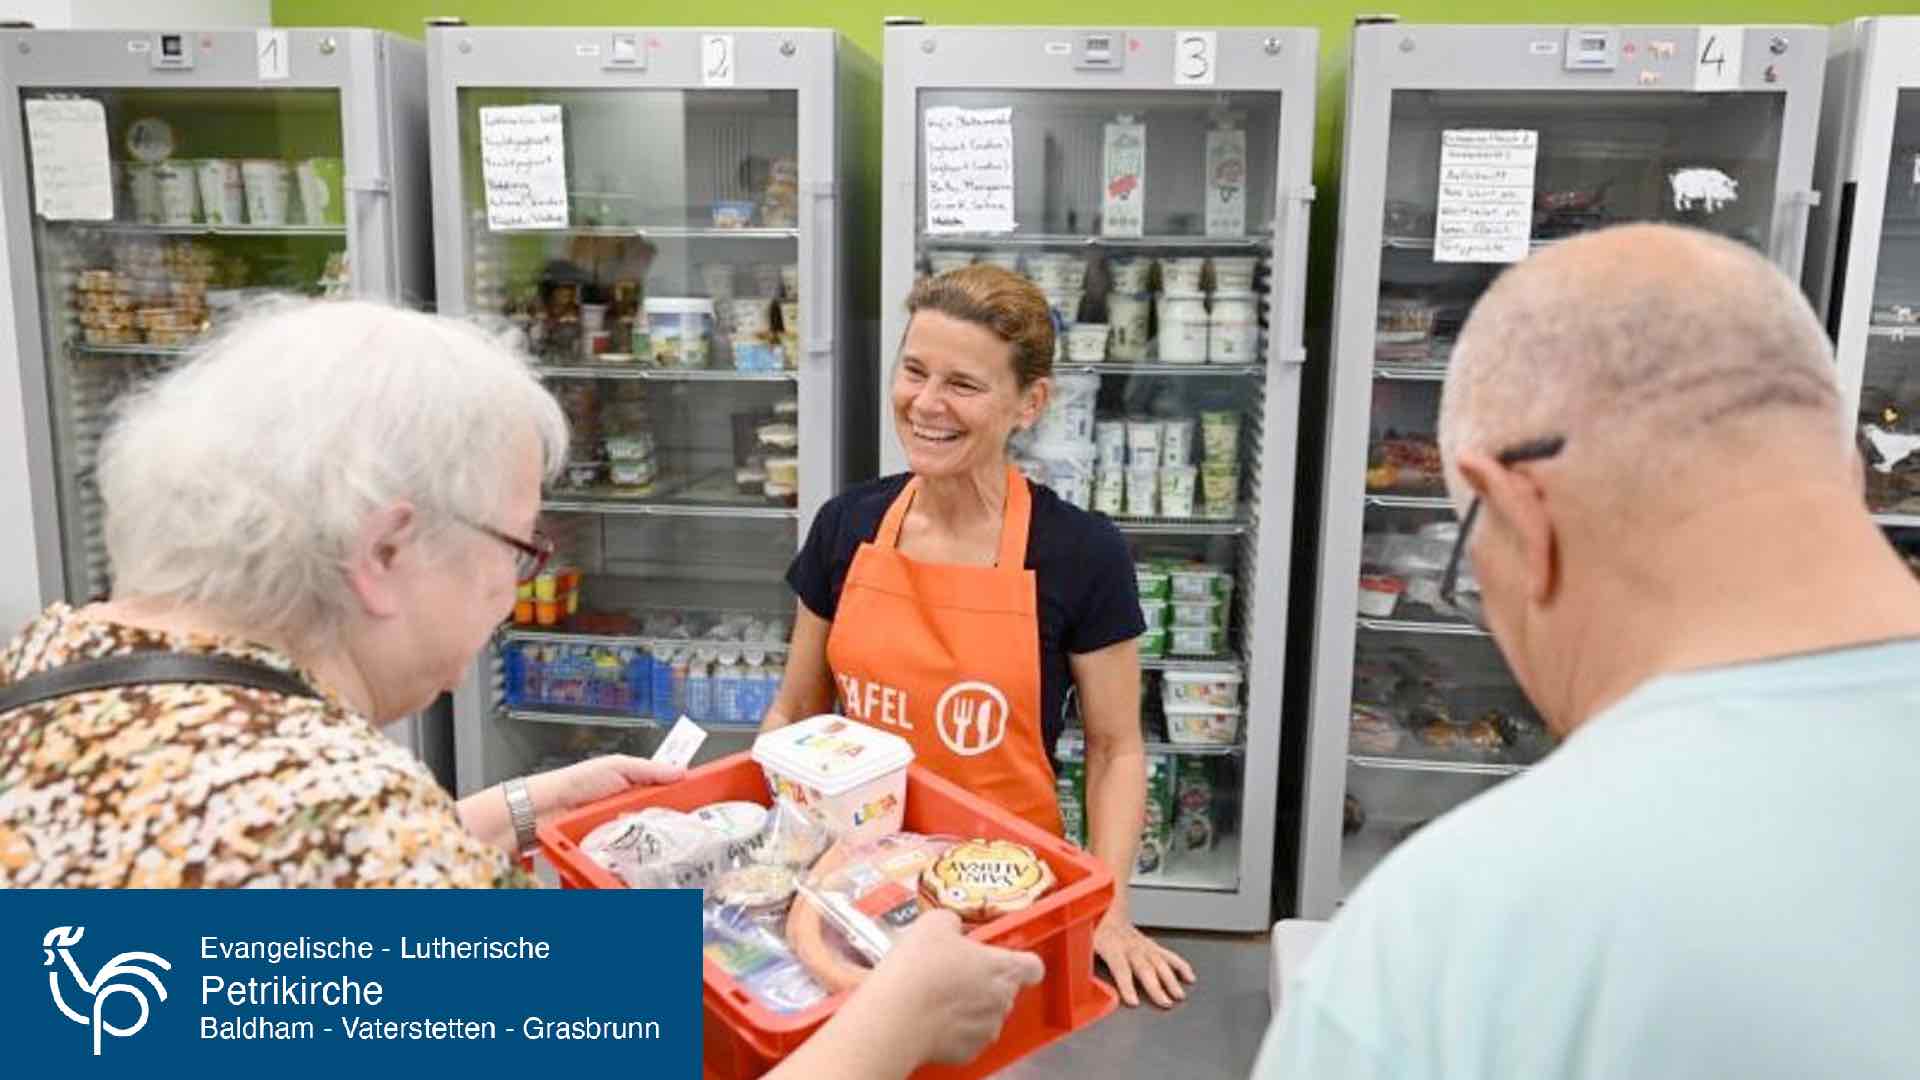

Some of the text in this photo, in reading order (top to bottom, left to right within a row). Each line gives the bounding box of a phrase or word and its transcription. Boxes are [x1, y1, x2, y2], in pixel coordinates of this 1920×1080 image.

[261, 37, 277, 73] 1
[708, 38, 729, 78] 2
[1183, 36, 1209, 79] 3
[1700, 35, 1725, 77] 4
[837, 672, 914, 730] TAFEL
